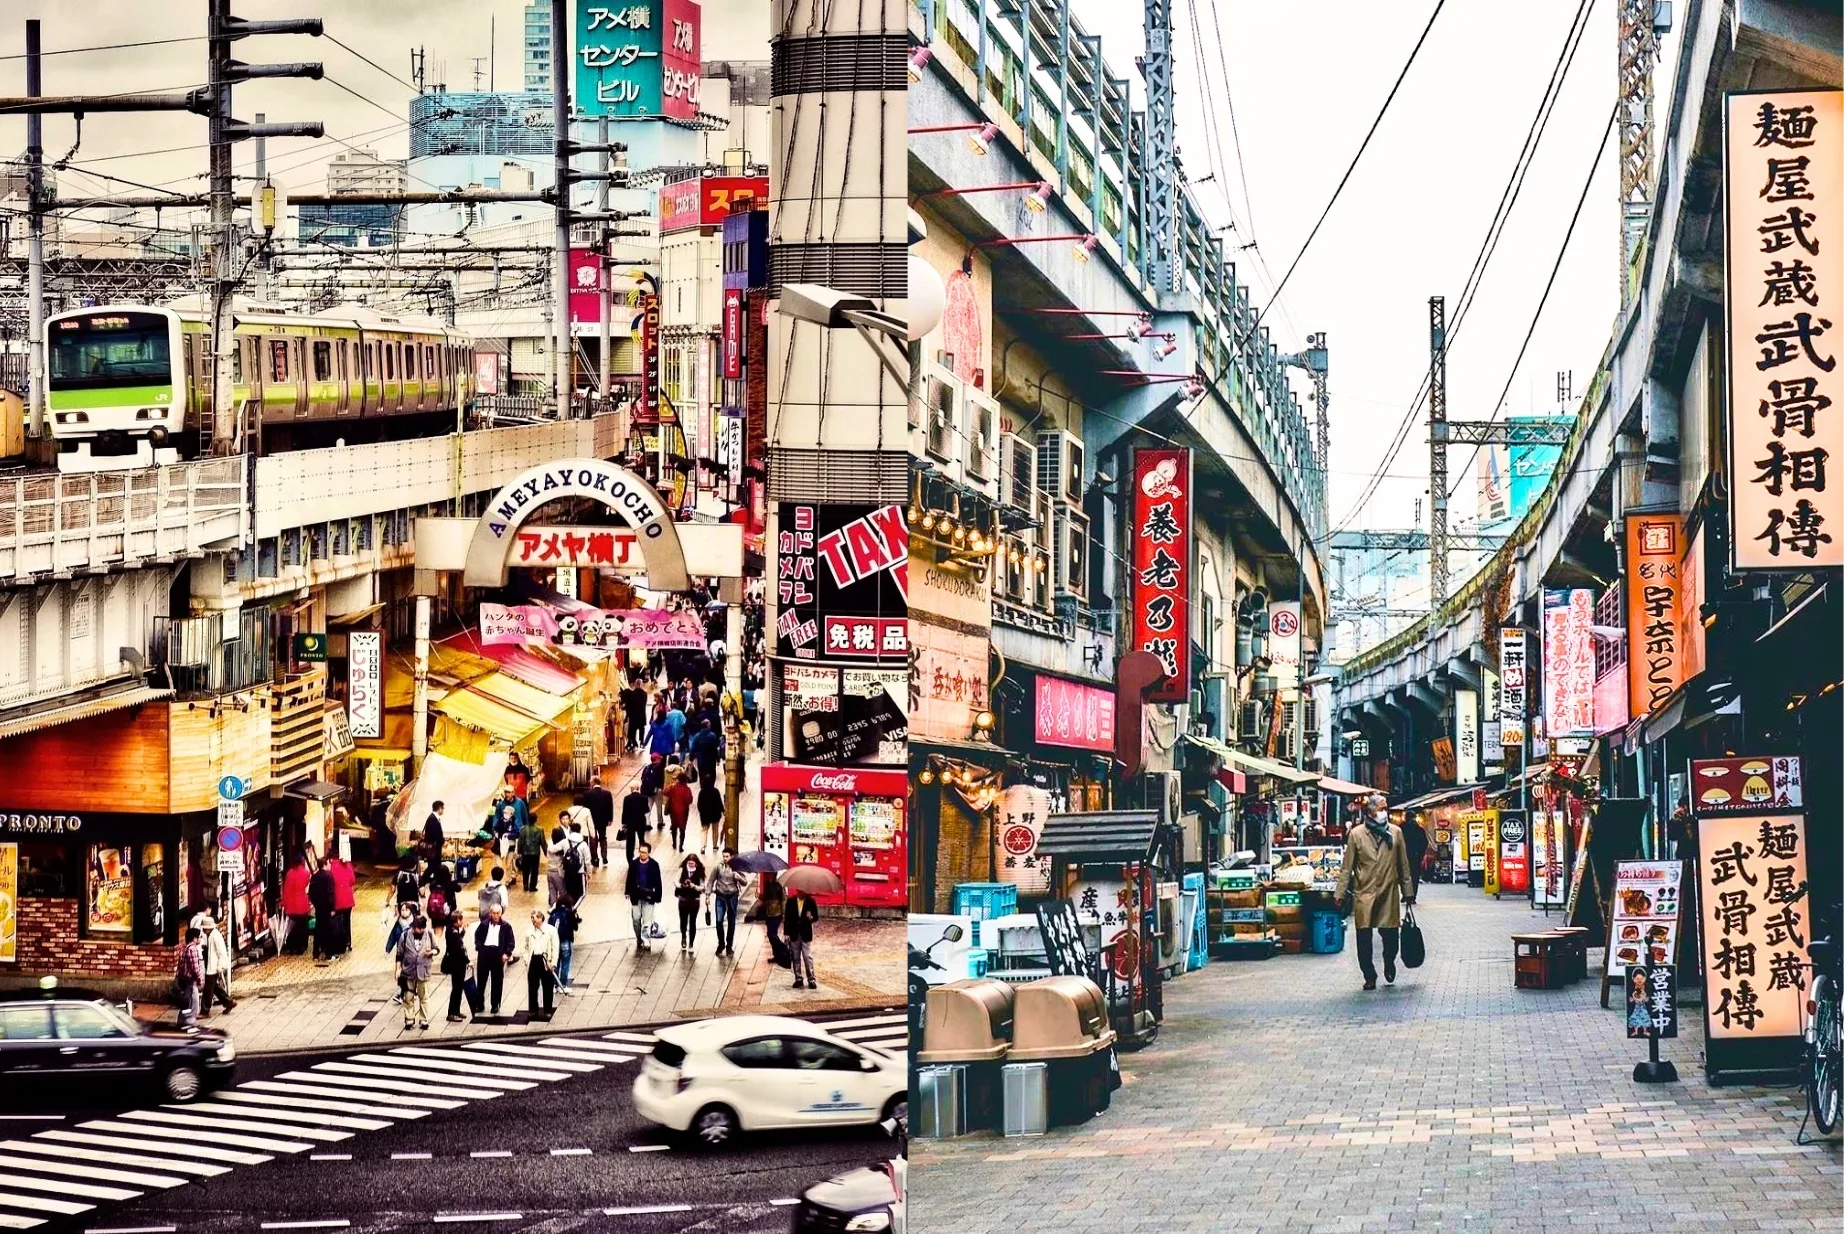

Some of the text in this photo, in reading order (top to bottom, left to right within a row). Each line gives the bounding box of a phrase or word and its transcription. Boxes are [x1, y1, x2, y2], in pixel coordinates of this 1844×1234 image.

[587, 7, 650, 30] アメ横
[580, 44, 658, 67] センター
[597, 79, 640, 103] ビル
[647, 298, 659, 346] スロット
[728, 308, 737, 372] GAME
[155, 393, 168, 401] JR
[488, 469, 663, 539] AMEYAYOKOCHO
[517, 532, 638, 565] アメヤ横丁
[794, 507, 814, 605] ヨドバシ
[819, 505, 908, 589] TAX
[780, 531, 793, 604] カメラ
[777, 609, 799, 637] TAX
[790, 620, 818, 648] FREE
[829, 624, 907, 650] 免税品
[1644, 586, 1675, 713] 宇奈とと
[352, 649, 366, 720] じゅらく
[784, 667, 838, 679] ヨドバシカメラ
[884, 726, 908, 742] VISA
[811, 773, 857, 790] Coca-Cola
[0, 815, 81, 830] PRONTO
[1003, 812, 1035, 825] 上野
[1506, 821, 1520, 829] TAX
[1005, 856, 1036, 868] 蕎麦
[1650, 967, 1672, 1035] 営業中
